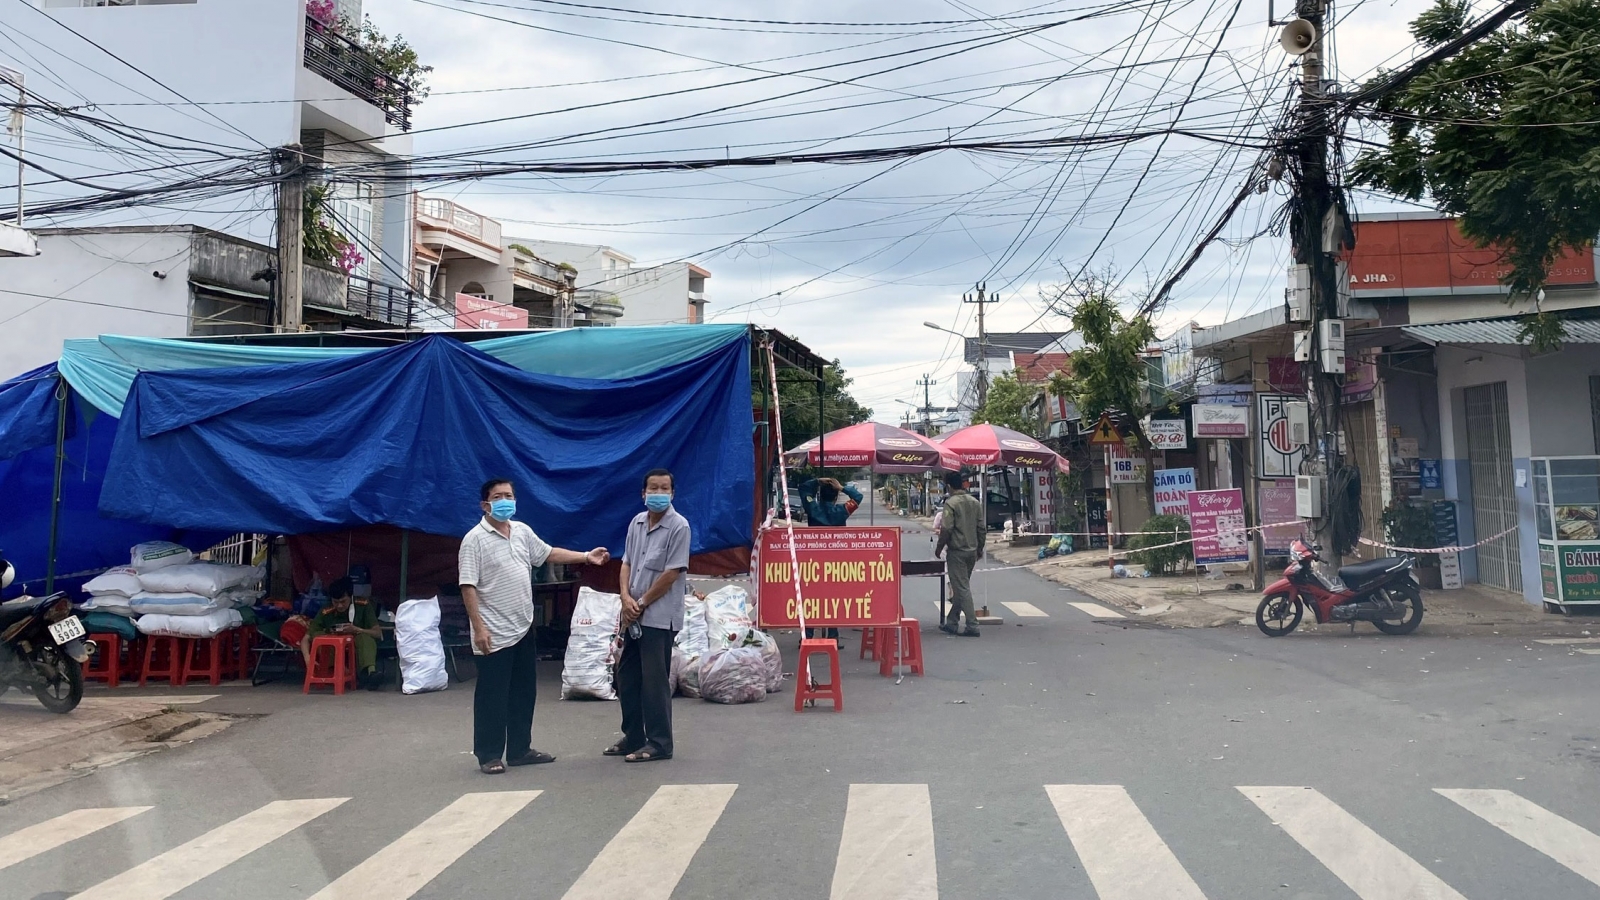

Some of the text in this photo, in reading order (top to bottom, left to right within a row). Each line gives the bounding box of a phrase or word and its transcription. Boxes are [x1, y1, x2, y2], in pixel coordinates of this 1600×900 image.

[1168, 432, 1185, 444] Bi
[814, 453, 869, 464] ww.mehyco.com.vn
[892, 453, 924, 463] Coffee
[1014, 455, 1043, 466] Coffee
[1114, 460, 1132, 472] 16B
[1155, 487, 1189, 503] HOÀN
[1198, 493, 1234, 508] Cherry
[803, 532, 819, 540] NHÂN
[820, 532, 832, 540] DÂN
[833, 532, 857, 540] PHƯỜNG
[858, 531, 870, 540] TÂN
[870, 531, 882, 541] LẬP
[807, 541, 827, 550] PHÒNG
[828, 541, 848, 550] CHỐNG
[851, 541, 866, 550] DỊCH
[866, 541, 894, 549] COVID-19
[765, 562, 792, 583] KHU
[823, 561, 866, 583] PHONG
[868, 553, 895, 582] TỎA
[824, 598, 840, 620] LY
[843, 598, 852, 619] Y
[855, 589, 874, 619] TẾ
[58, 626, 81, 642] 5903
